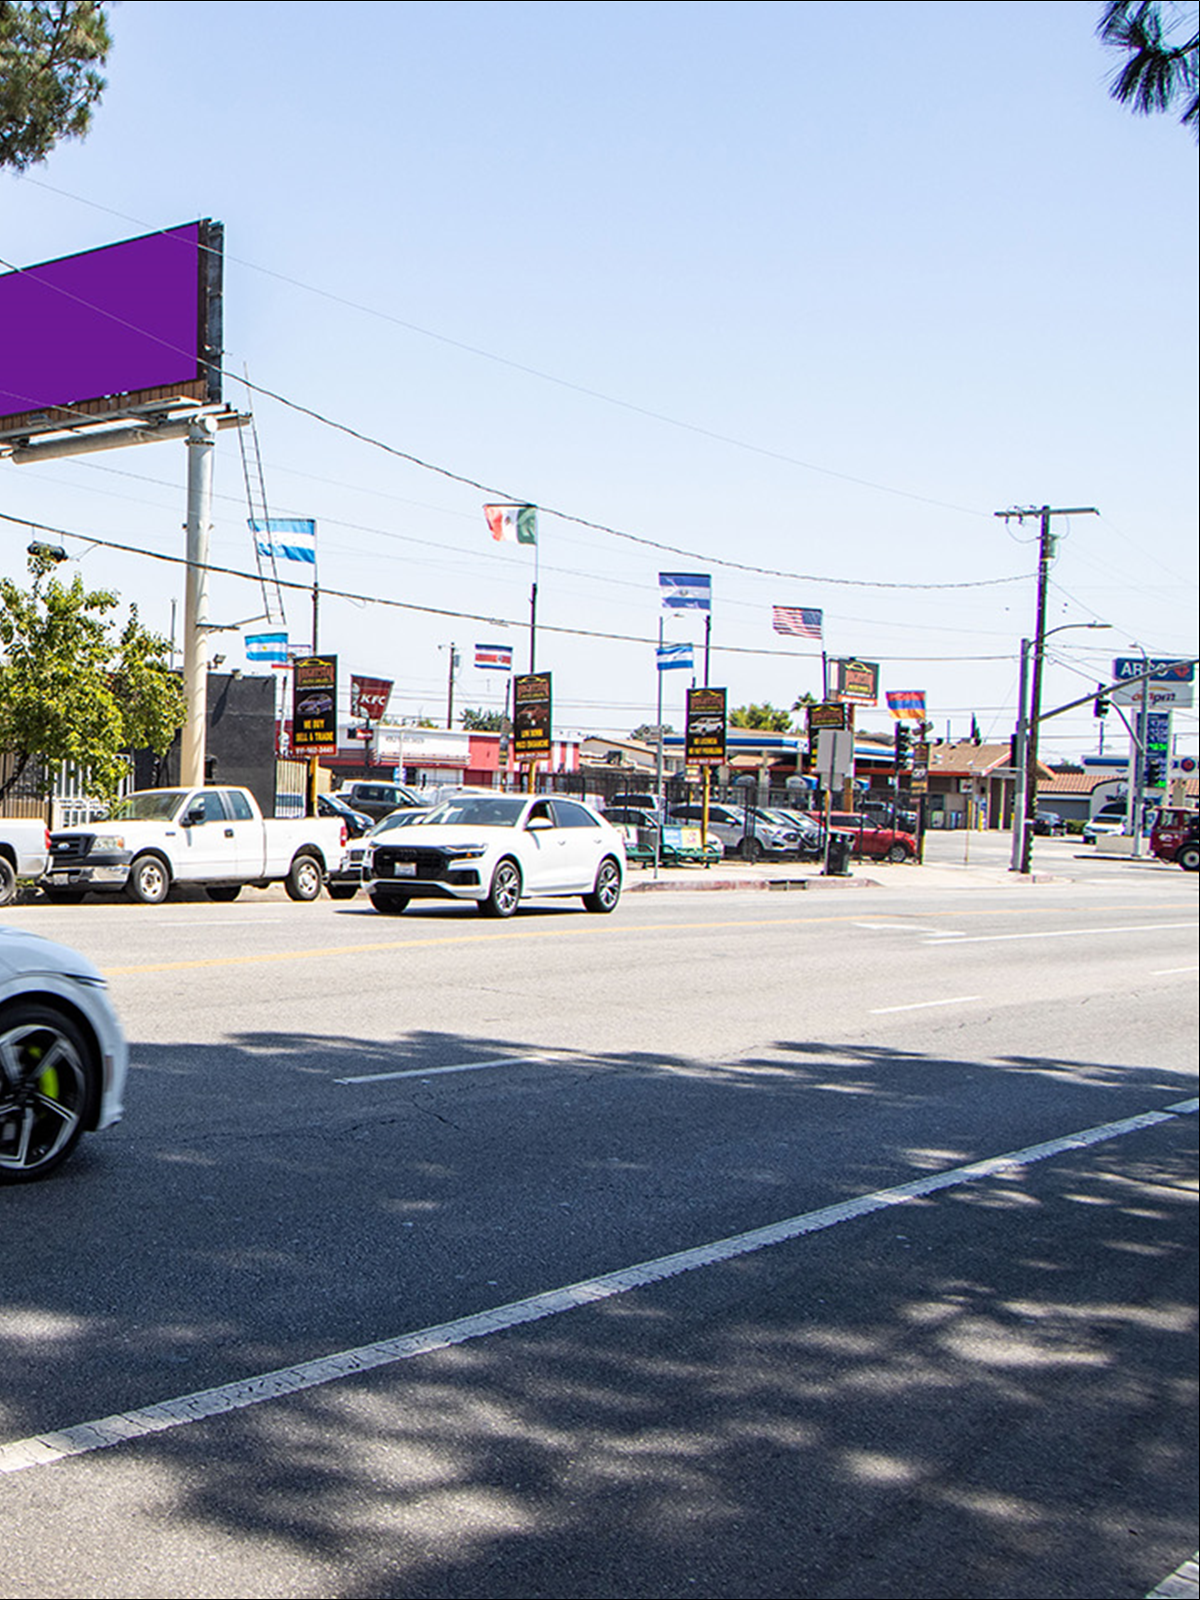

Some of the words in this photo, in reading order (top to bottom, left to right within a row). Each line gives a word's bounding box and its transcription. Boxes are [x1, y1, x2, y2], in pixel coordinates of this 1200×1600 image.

[360, 694, 387, 706] KFC
[303, 719, 311, 729] WE
[313, 719, 325, 729] BUY
[295, 731, 308, 742] SELL
[315, 731, 334, 742] TRADE
